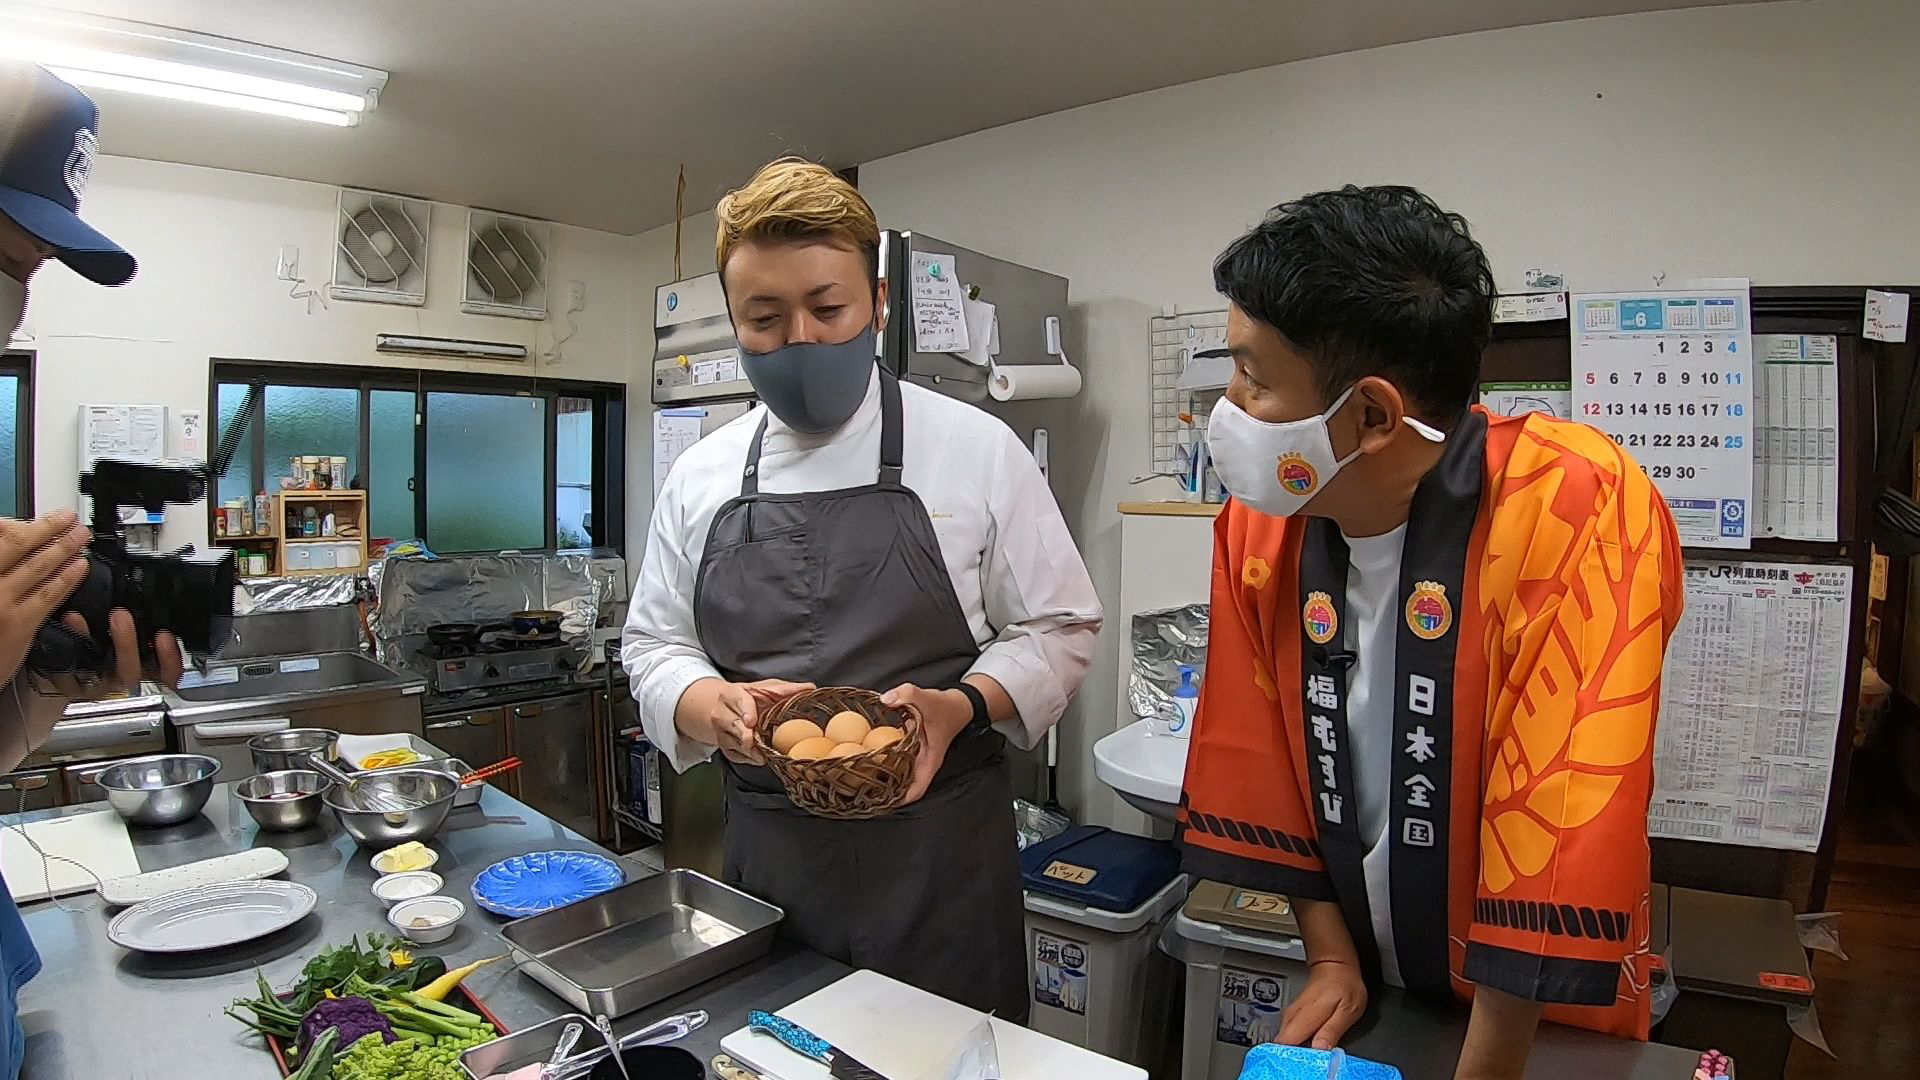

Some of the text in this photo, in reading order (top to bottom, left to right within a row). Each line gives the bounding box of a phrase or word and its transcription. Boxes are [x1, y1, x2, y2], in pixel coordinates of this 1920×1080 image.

[1635, 312, 1647, 328] 6
[1657, 341, 1737, 354] 1 2 3 4
[1586, 372, 1741, 385] 5 6 7 8 9 10 11
[1583, 403, 1600, 415] 12
[1606, 403, 1624, 416] 13
[1630, 403, 1648, 416] 14
[1654, 403, 1672, 416] 15
[1677, 403, 1696, 416] 16
[1701, 404, 1719, 417] 17
[1726, 404, 1743, 417] 18
[1629, 434, 1647, 447] 21
[1653, 435, 1672, 447] 22
[1676, 435, 1696, 448] 23
[1700, 435, 1719, 448] 24
[1725, 436, 1743, 449] 25
[1653, 465, 1672, 478] 29
[1676, 466, 1695, 479] 30
[1709, 565, 1790, 581] JR列車時刻表
[1307, 674, 1343, 825] 福むすび
[1402, 673, 1437, 847] 日本全国
[1047, 865, 1085, 881] ペット
[1241, 895, 1279, 911] プラ
